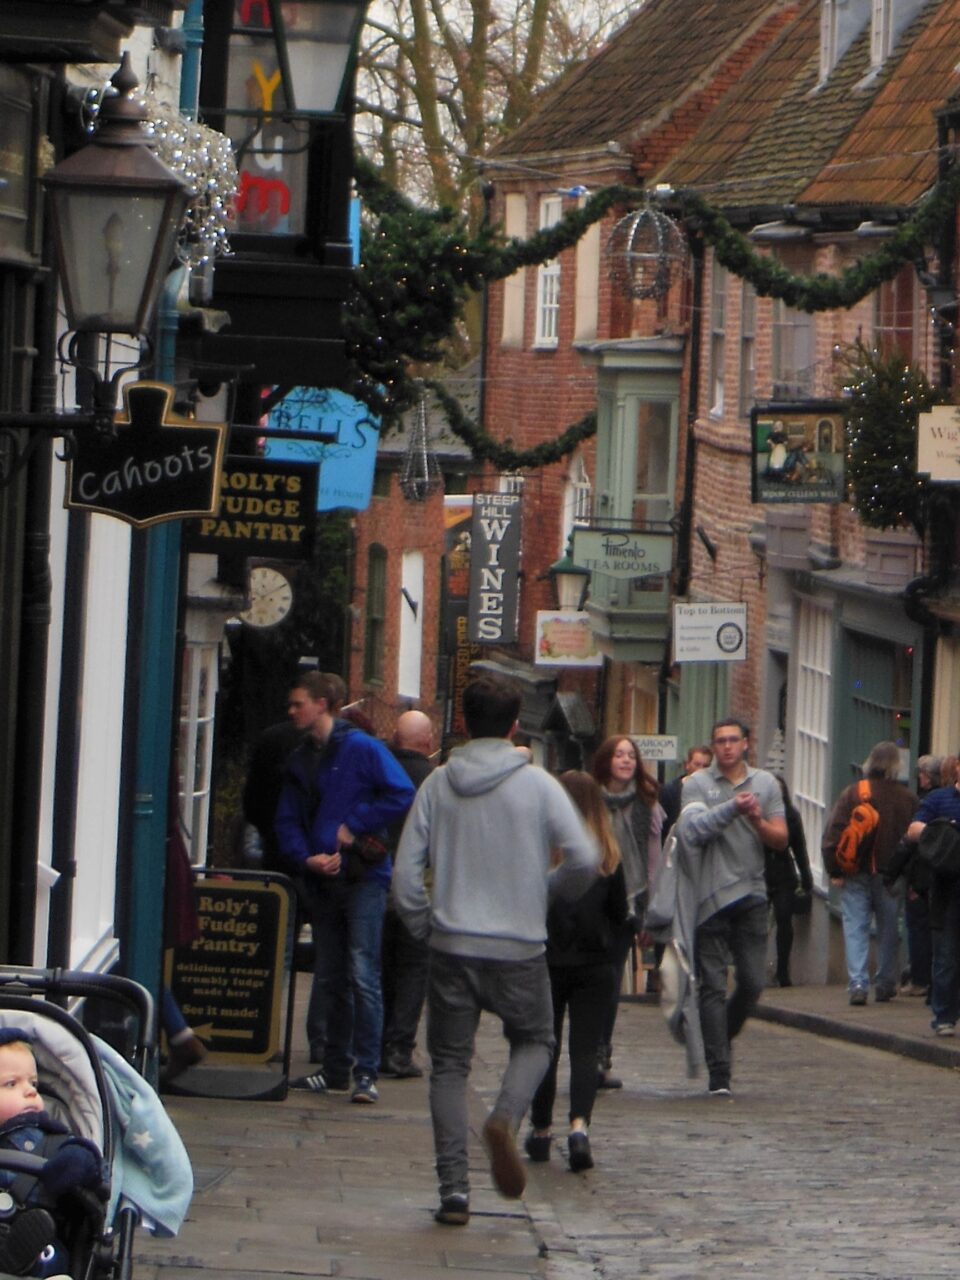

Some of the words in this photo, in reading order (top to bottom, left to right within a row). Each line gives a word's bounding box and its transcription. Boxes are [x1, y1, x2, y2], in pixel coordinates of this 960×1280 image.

[79, 446, 212, 500] Cahoots
[476, 494, 519, 506] STEEP
[481, 507, 512, 518] HILL
[200, 519, 306, 542] PANTRY
[584, 558, 610, 570] TEA
[613, 561, 661, 572] ROOMS
[478, 519, 511, 639] WINES
[678, 606, 695, 617] Top
[698, 607, 707, 615] to
[710, 606, 746, 616] Bottom
[198, 896, 259, 915] Roly's
[197, 916, 258, 937] Fudge
[192, 937, 260, 956] Pantry
[176, 962, 226, 972] delicious
[181, 975, 228, 987] crumbly
[232, 976, 265, 988] fudge
[193, 987, 223, 997] made
[226, 987, 250, 998] here
[182, 1003, 204, 1015] See
[206, 1003, 218, 1016] it
